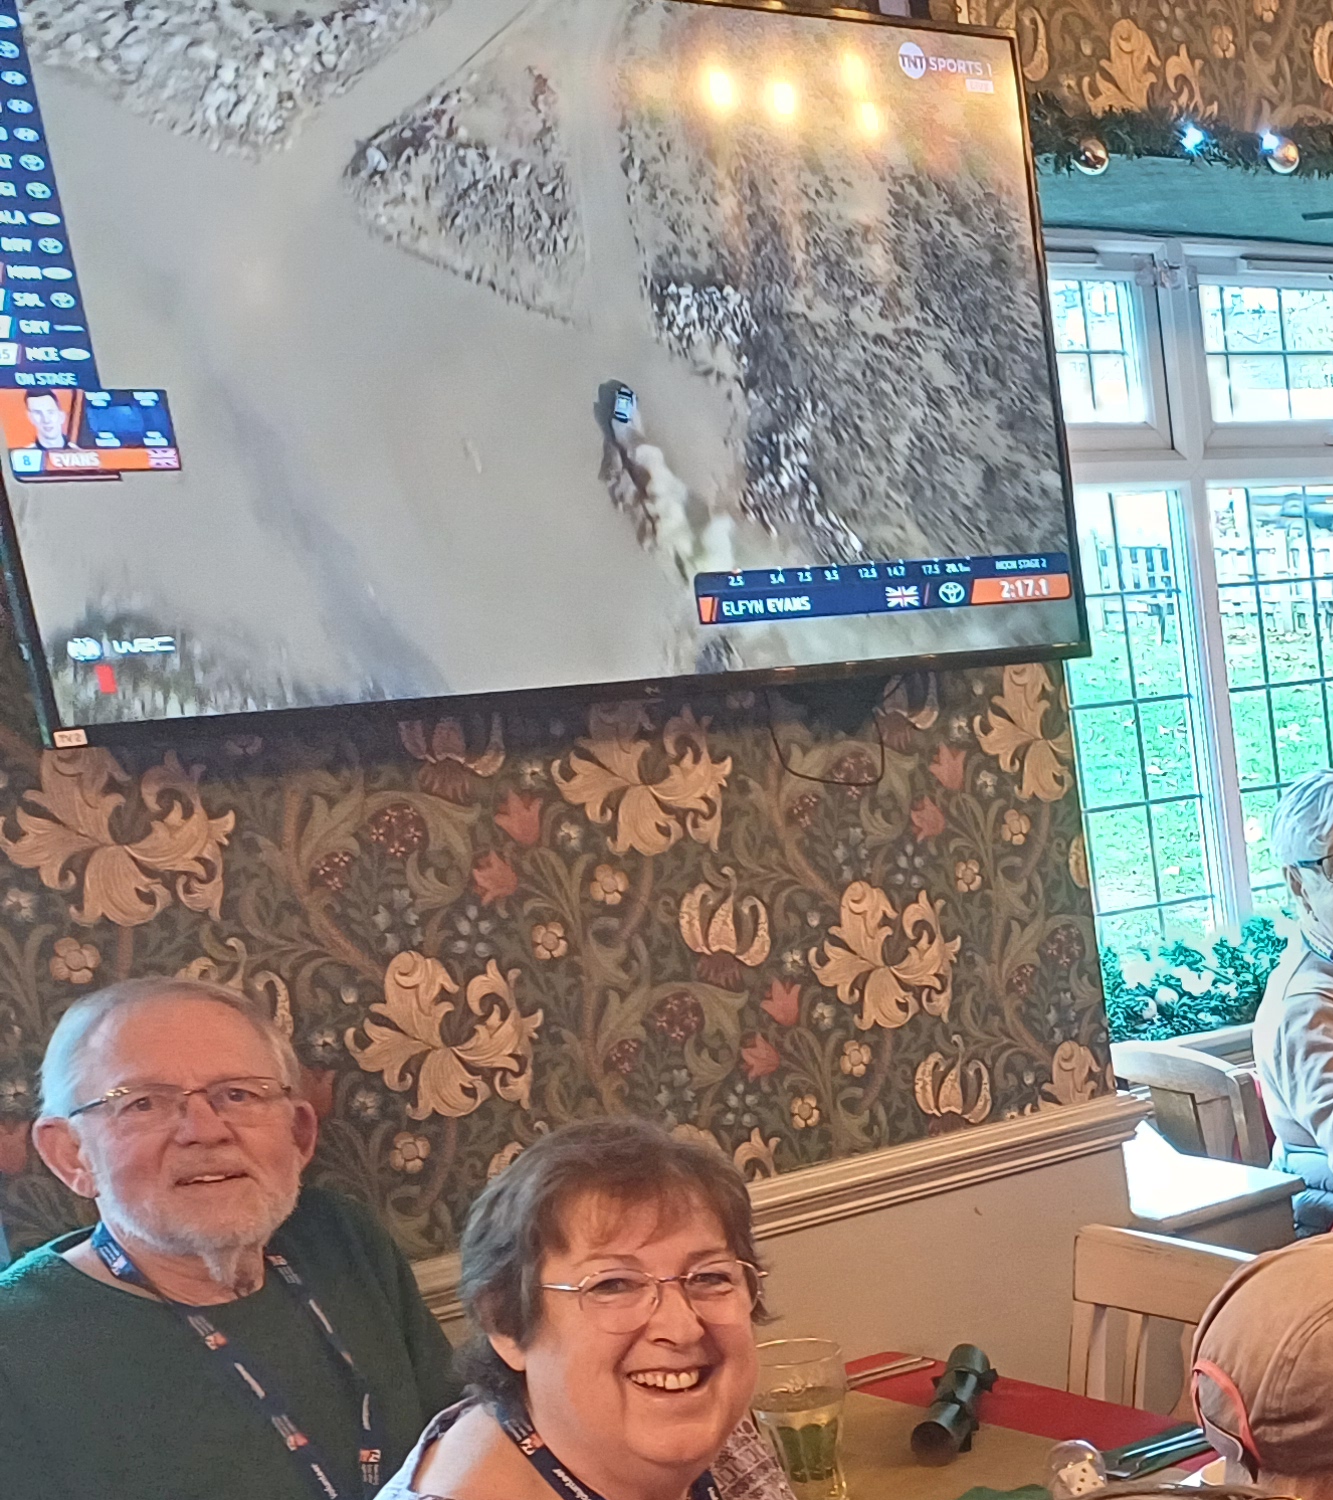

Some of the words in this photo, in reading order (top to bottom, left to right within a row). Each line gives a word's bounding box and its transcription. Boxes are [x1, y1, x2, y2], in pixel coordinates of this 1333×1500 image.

[899, 53, 925, 70] TNT
[928, 57, 983, 76] SPORTS
[986, 62, 993, 77] 1
[22, 455, 31, 466] 8
[51, 452, 100, 468] EVANS
[999, 578, 1049, 599] 2:17.1
[721, 598, 765, 617] ELFYN
[765, 595, 812, 614] EVANS
[112, 636, 176, 654] WRC
